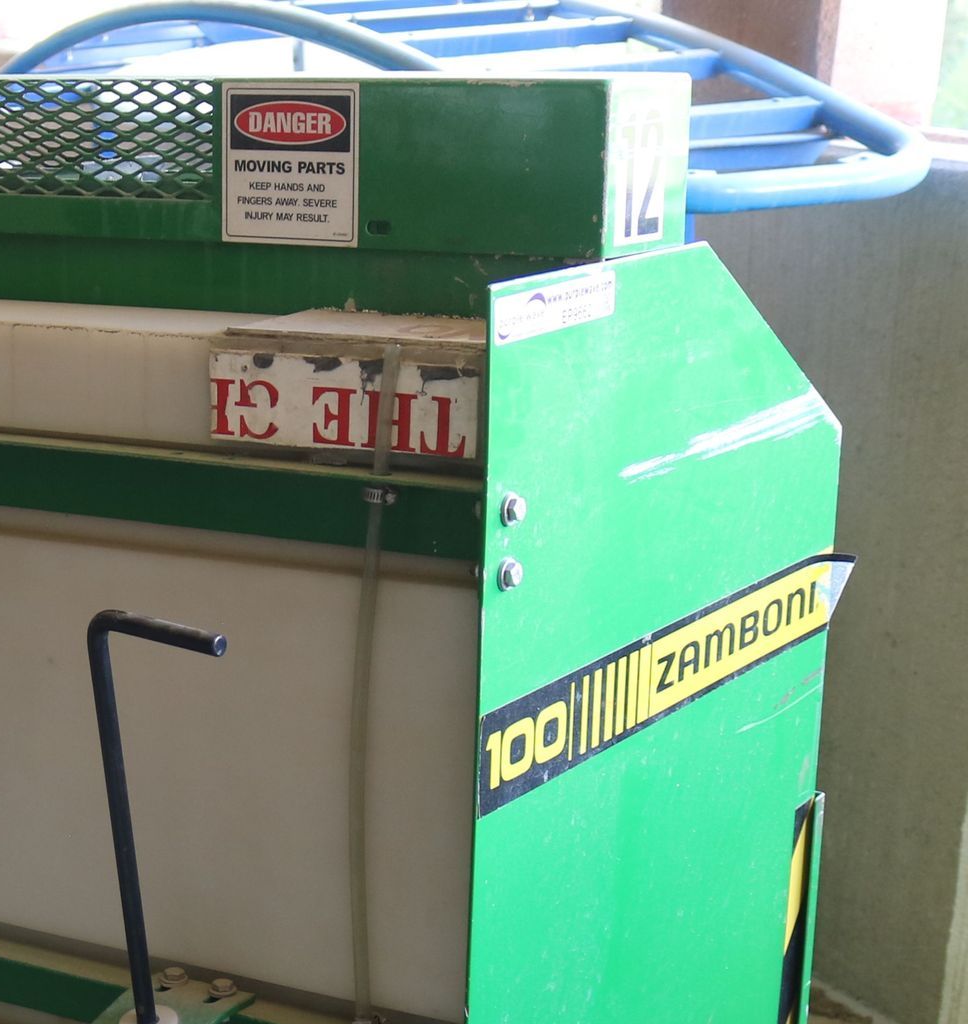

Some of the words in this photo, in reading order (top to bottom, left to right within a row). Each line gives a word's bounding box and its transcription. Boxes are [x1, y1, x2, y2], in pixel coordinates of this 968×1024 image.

[248, 111, 332, 135] DANGER
[234, 159, 293, 173] MOVING
[298, 161, 345, 175] PARTS
[622, 109, 664, 238] 12
[249, 182, 272, 191] KEEP
[274, 183, 304, 192] HANDS
[307, 183, 325, 192] AND
[237, 196, 272, 206] FINGERS
[275, 197, 301, 207] AWAY.
[303, 198, 337, 208] SEVERE
[244, 211, 274, 221] INJURY
[276, 212, 293, 221] MAY
[296, 213, 330, 223] RESULT.
[312, 386, 466, 458] THE
[486, 700, 567, 790] 100
[656, 581, 816, 694] ZAMBONI
